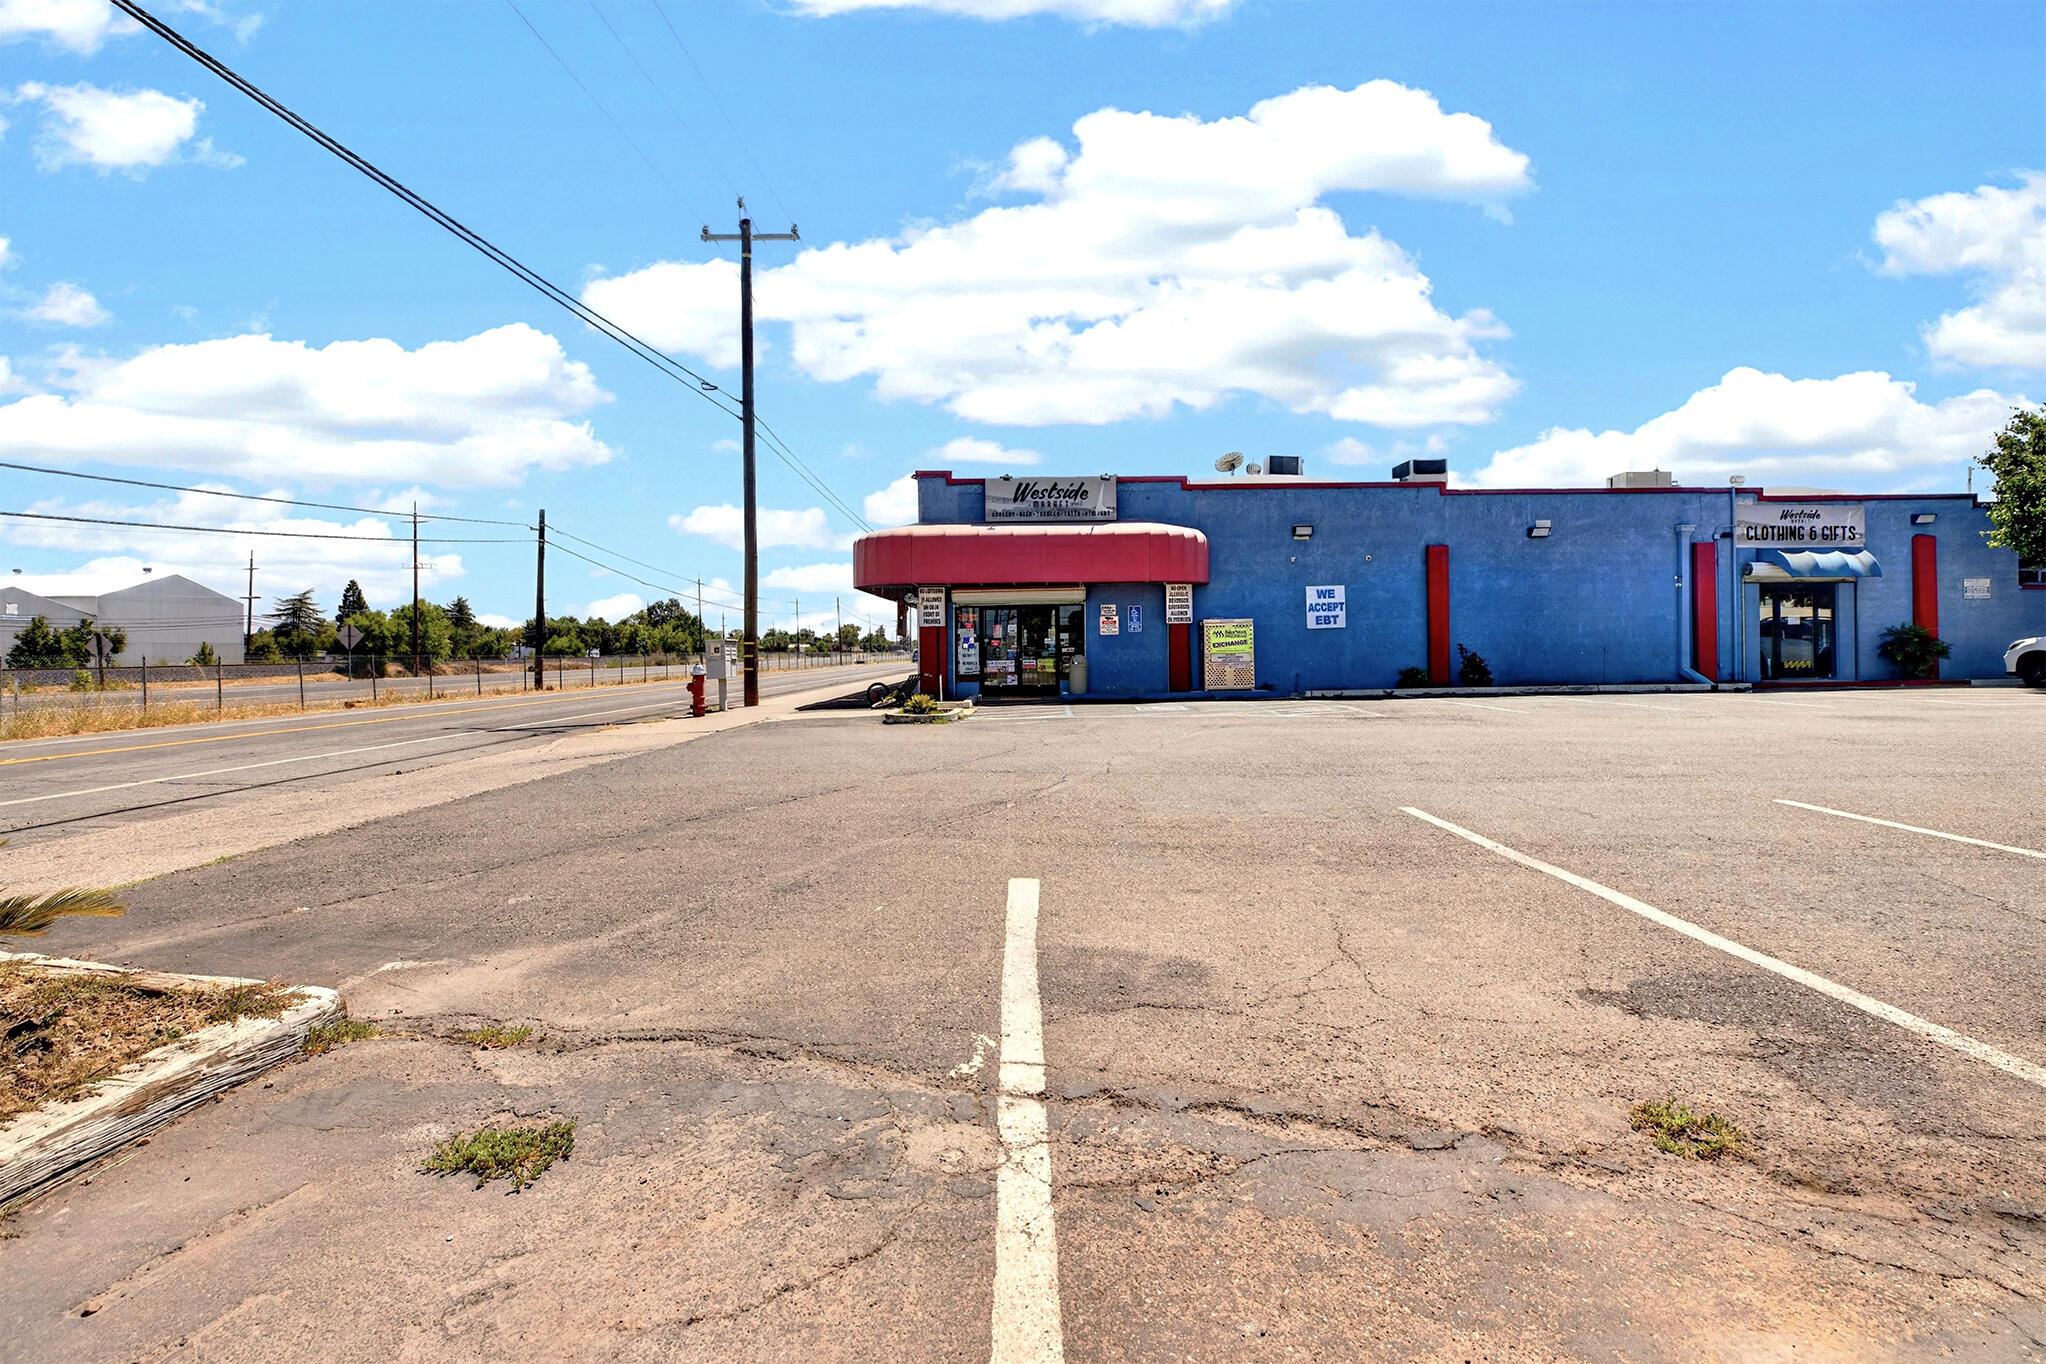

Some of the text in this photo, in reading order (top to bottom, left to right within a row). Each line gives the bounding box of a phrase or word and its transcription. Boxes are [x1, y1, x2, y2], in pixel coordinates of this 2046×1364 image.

[1013, 481, 1089, 502] Westside
[1780, 509, 1821, 521] Westside
[1746, 525, 1805, 541] CLOTHING
[1821, 525, 1856, 541] GIFTS
[1316, 589, 1335, 599] WE
[1308, 602, 1344, 612] ACCEPT
[1315, 615, 1339, 625] EBT
[1212, 639, 1248, 648] EXCHANGE
